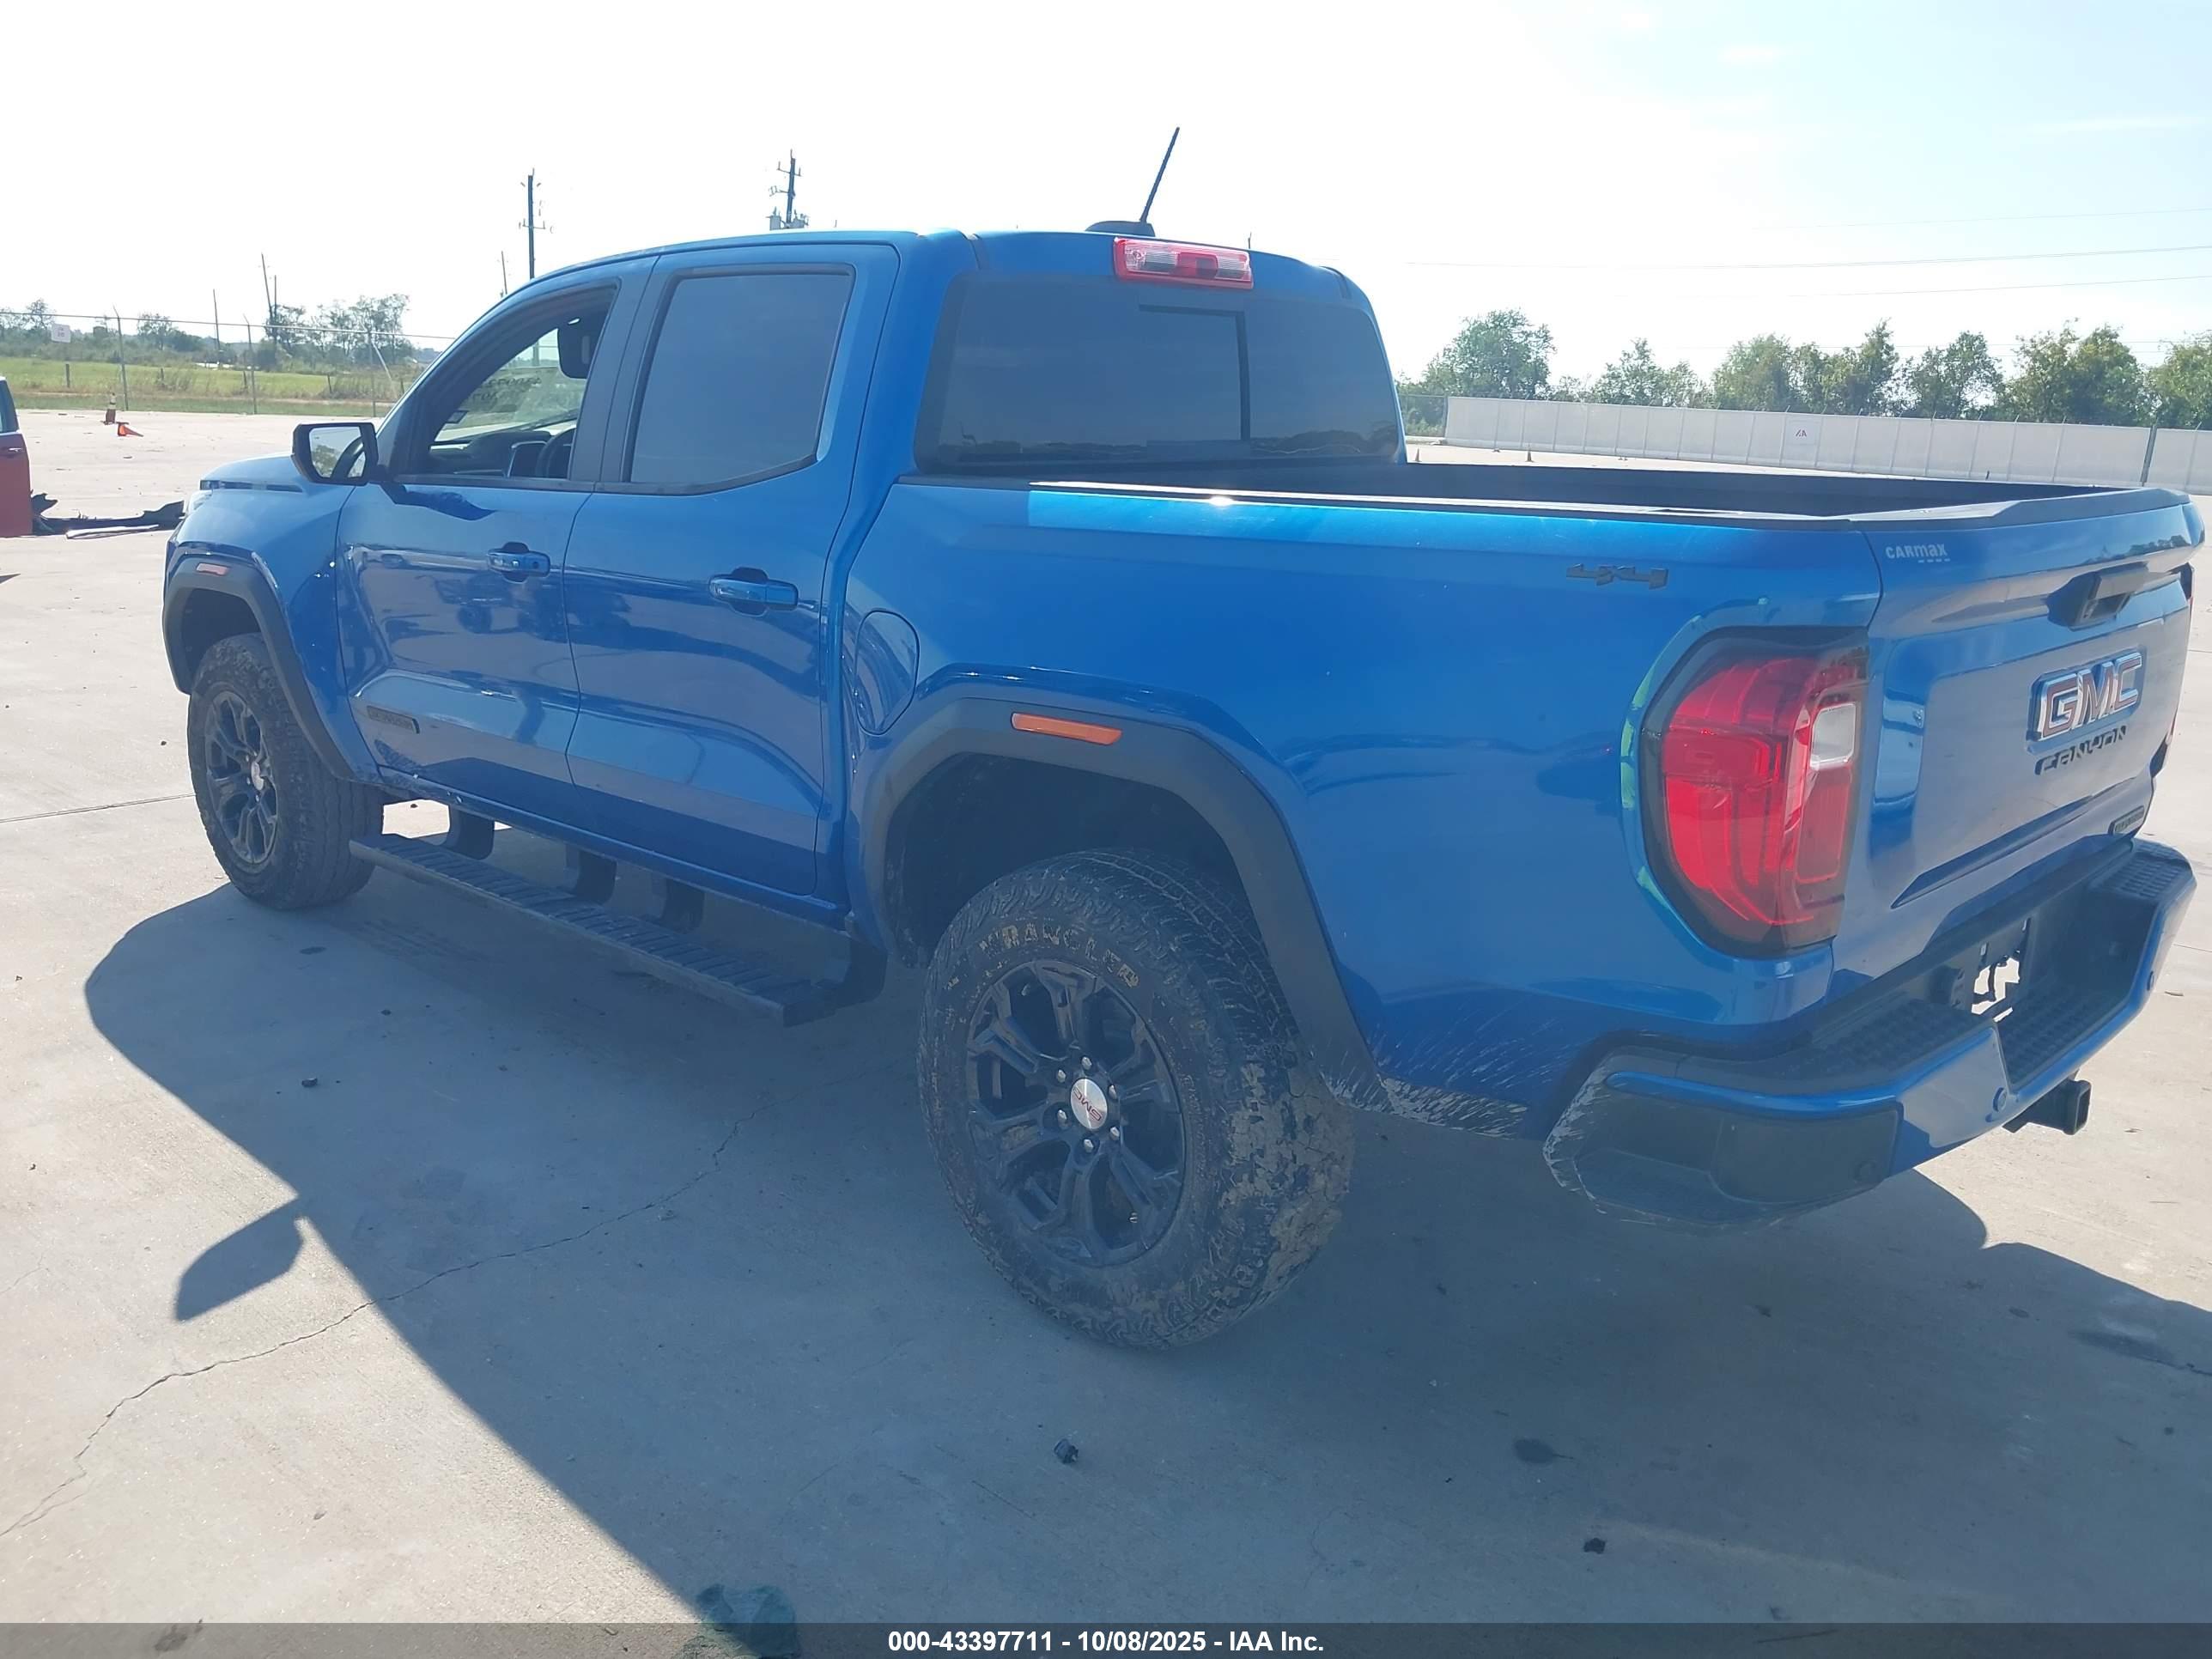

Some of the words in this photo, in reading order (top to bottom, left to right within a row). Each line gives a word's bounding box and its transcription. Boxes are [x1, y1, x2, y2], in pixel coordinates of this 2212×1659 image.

[2037, 652, 2142, 742] GMC
[2034, 725, 2127, 775] CANYON
[1073, 1085, 1103, 1121] GMC
